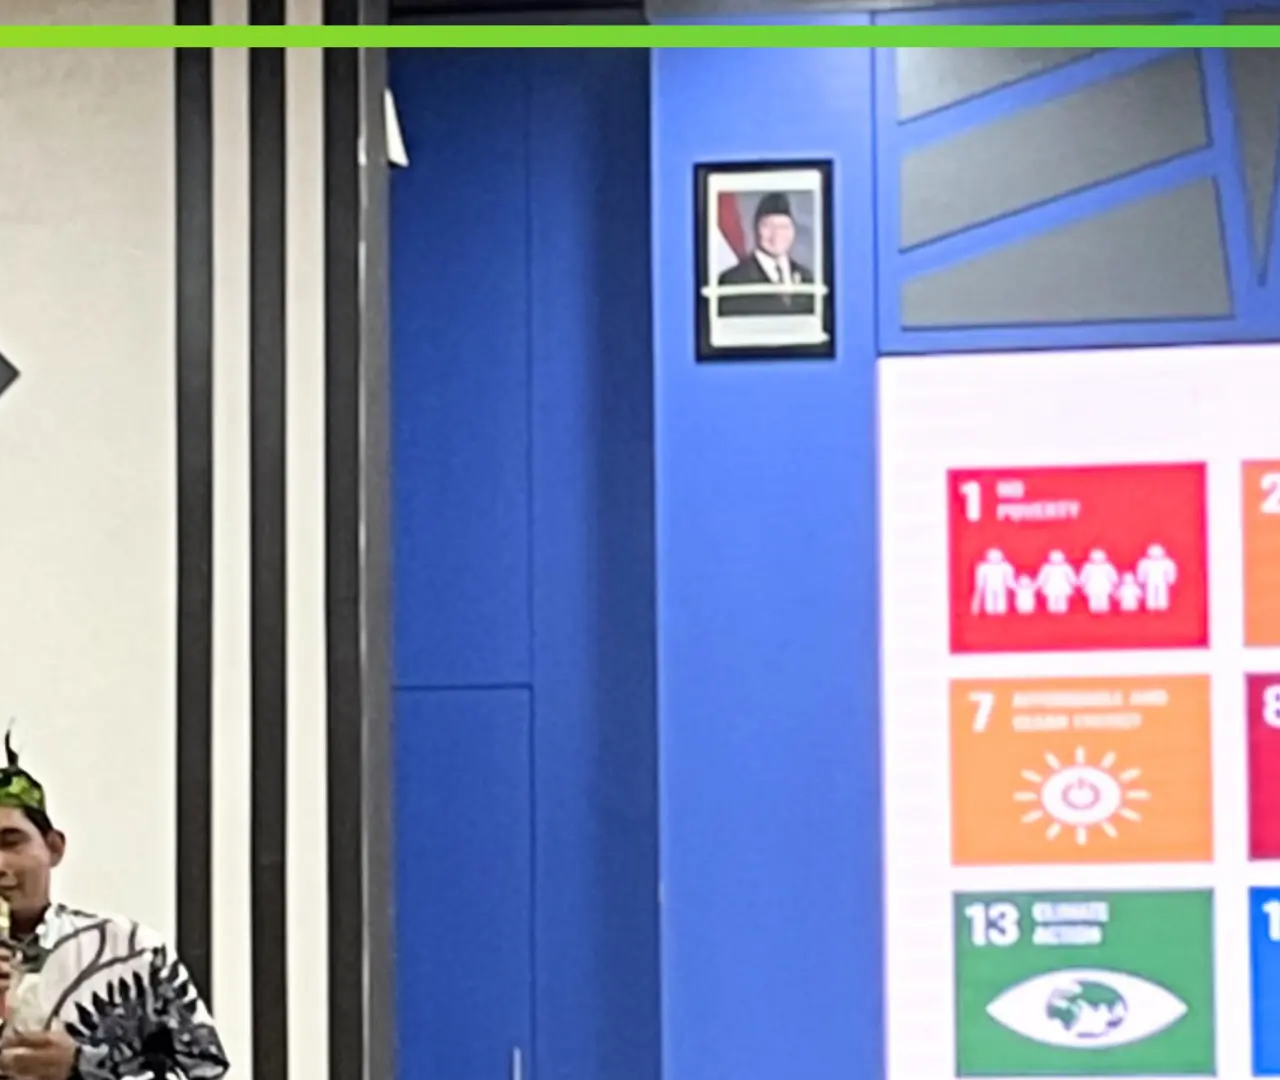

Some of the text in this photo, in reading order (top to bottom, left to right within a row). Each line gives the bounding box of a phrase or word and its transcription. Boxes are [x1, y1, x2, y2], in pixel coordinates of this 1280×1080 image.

[959, 480, 981, 523] 1
[968, 691, 994, 732] 7
[964, 901, 1020, 946] 13
